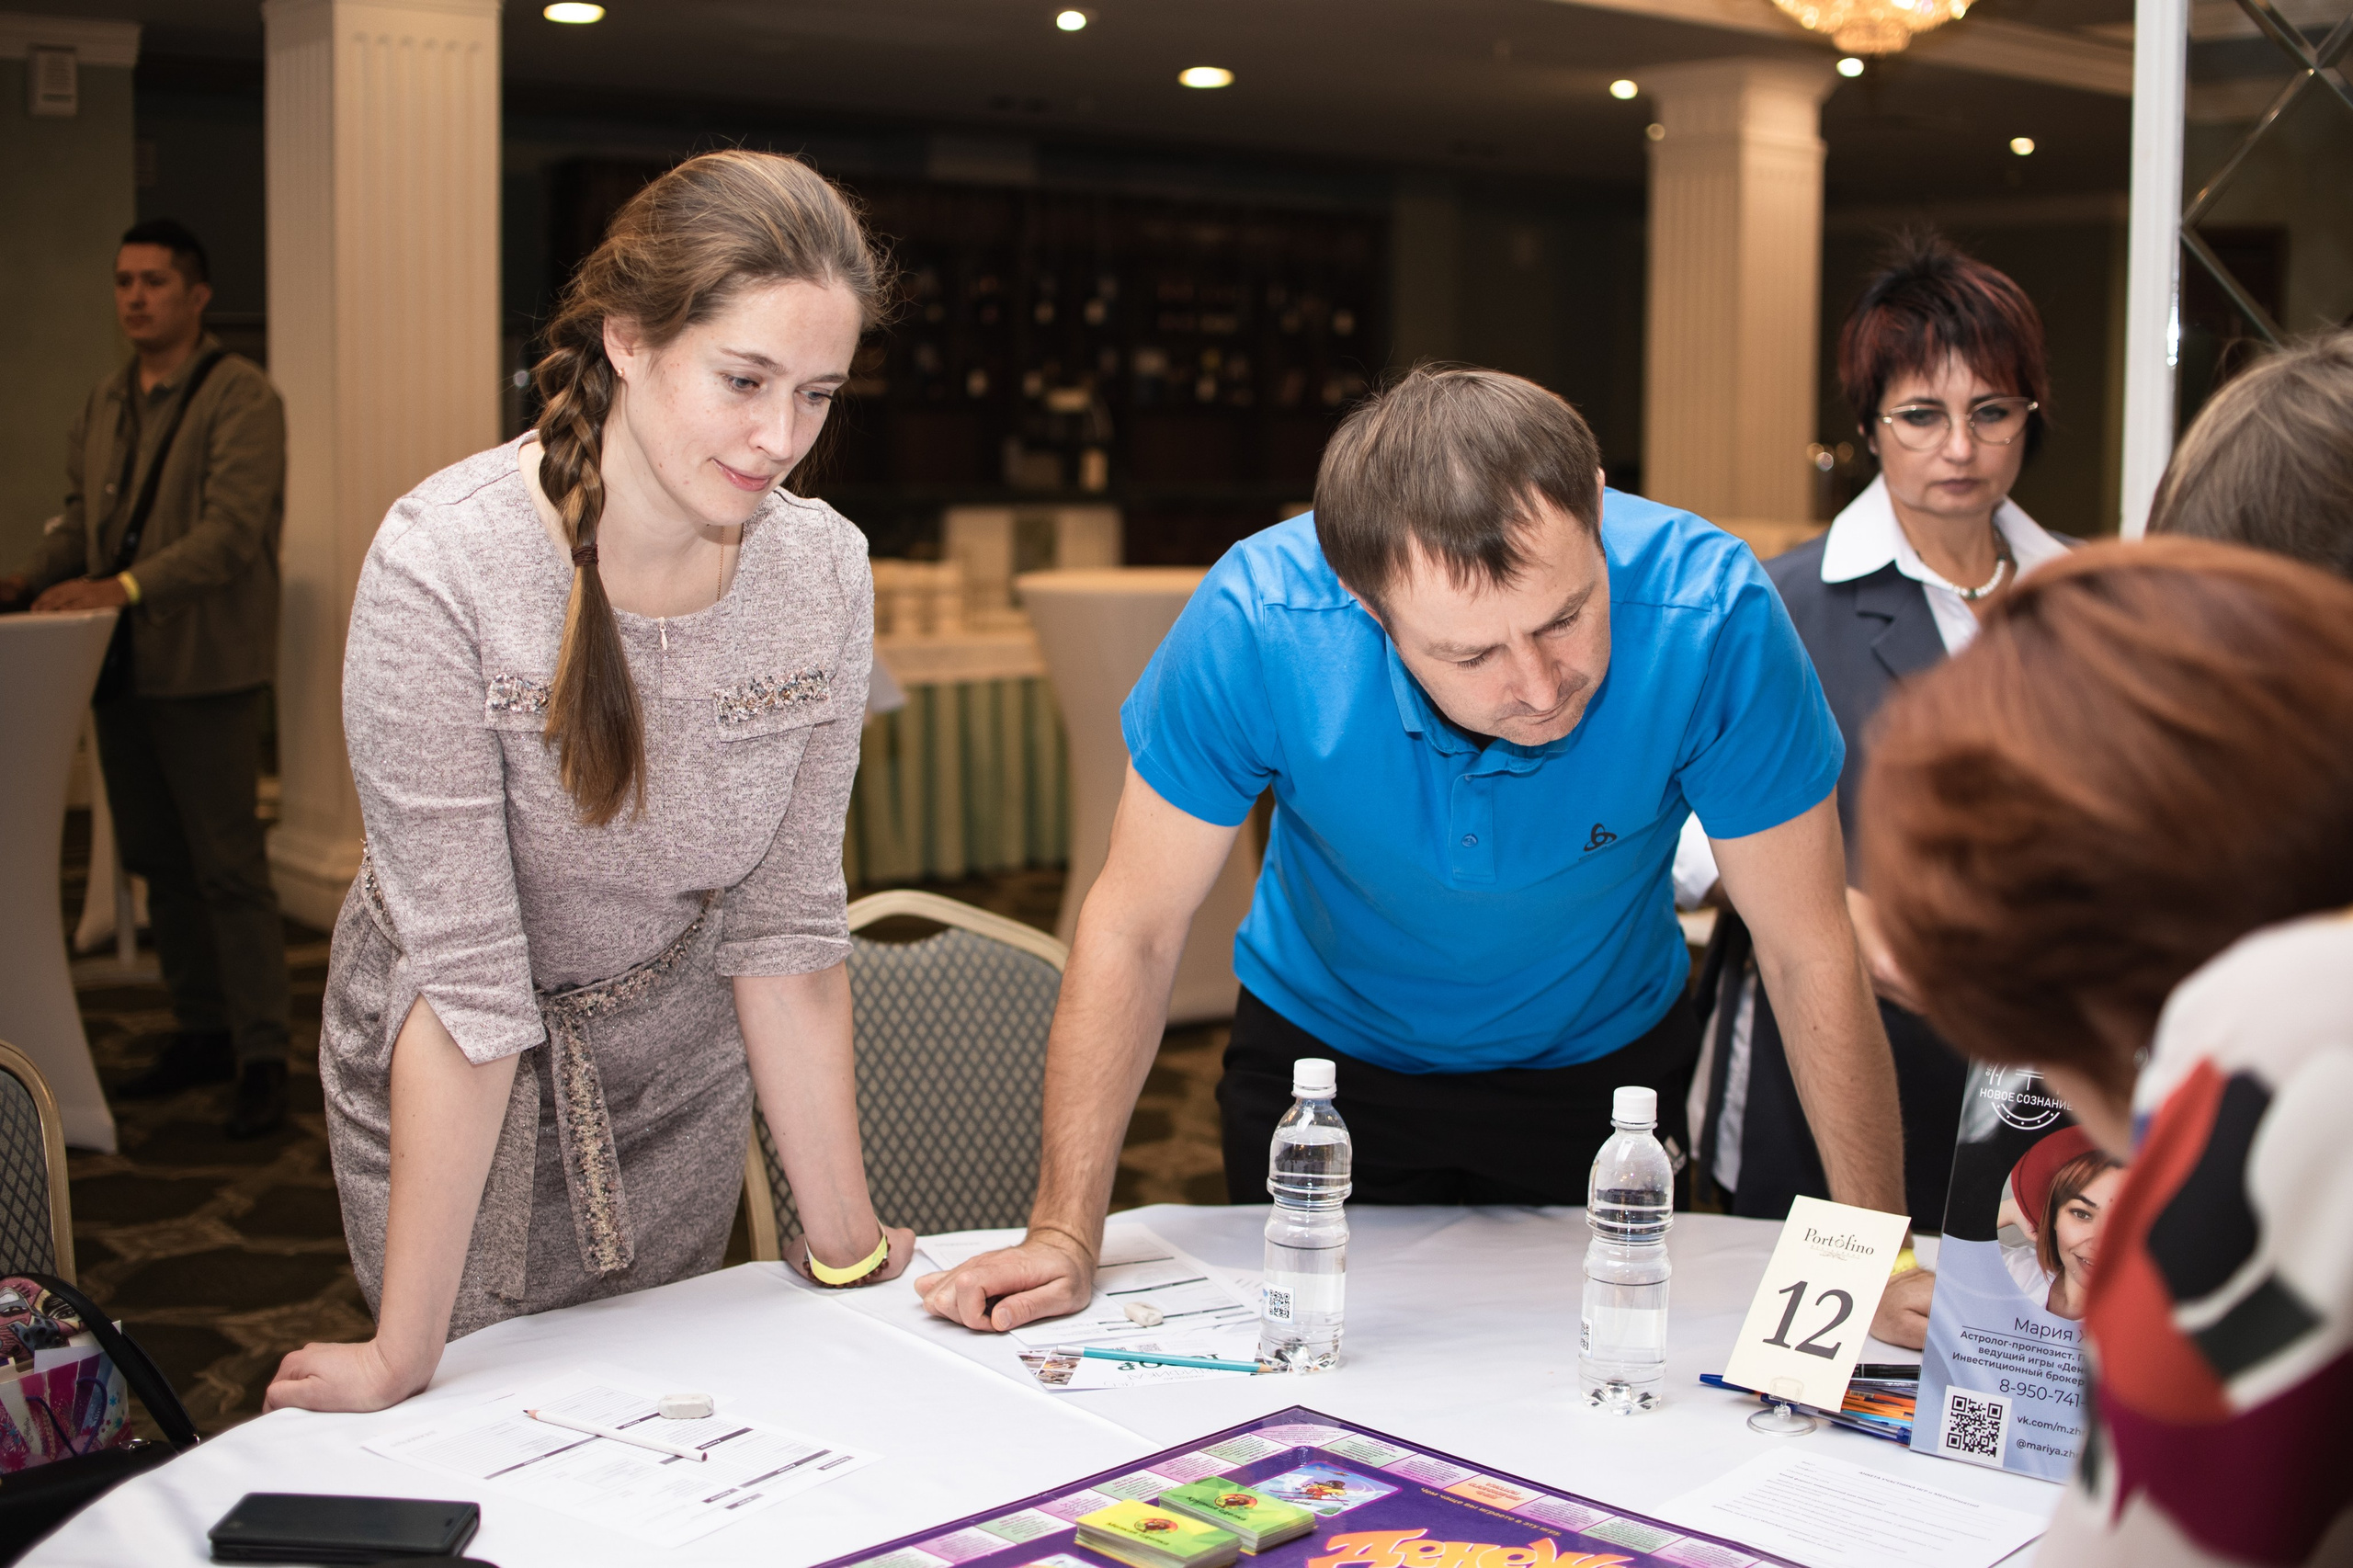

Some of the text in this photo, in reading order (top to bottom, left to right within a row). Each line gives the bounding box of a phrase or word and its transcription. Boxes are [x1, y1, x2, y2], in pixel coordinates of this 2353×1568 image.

[1979, 1087, 2015, 1102] НОВОЕ
[1803, 1227, 1874, 1256] Portofino
[1762, 1280, 1854, 1360] 12
[2014, 1317, 2073, 1342] Мария
[1960, 1330, 2075, 1361] Астролог-прогнозист.
[1978, 1346, 2026, 1363] ведущий
[2028, 1357, 2054, 1369] игры
[1952, 1351, 2085, 1387] Инвестиционный брокер
[2017, 1415, 2084, 1437] vk.com/m.zh
[2016, 1438, 2079, 1459] @mariya.zh
[1420, 1486, 1438, 1497] Чем
[1439, 1494, 1464, 1506] чаще
[1478, 1506, 1516, 1522] играете
[1522, 1521, 1540, 1530] эту
